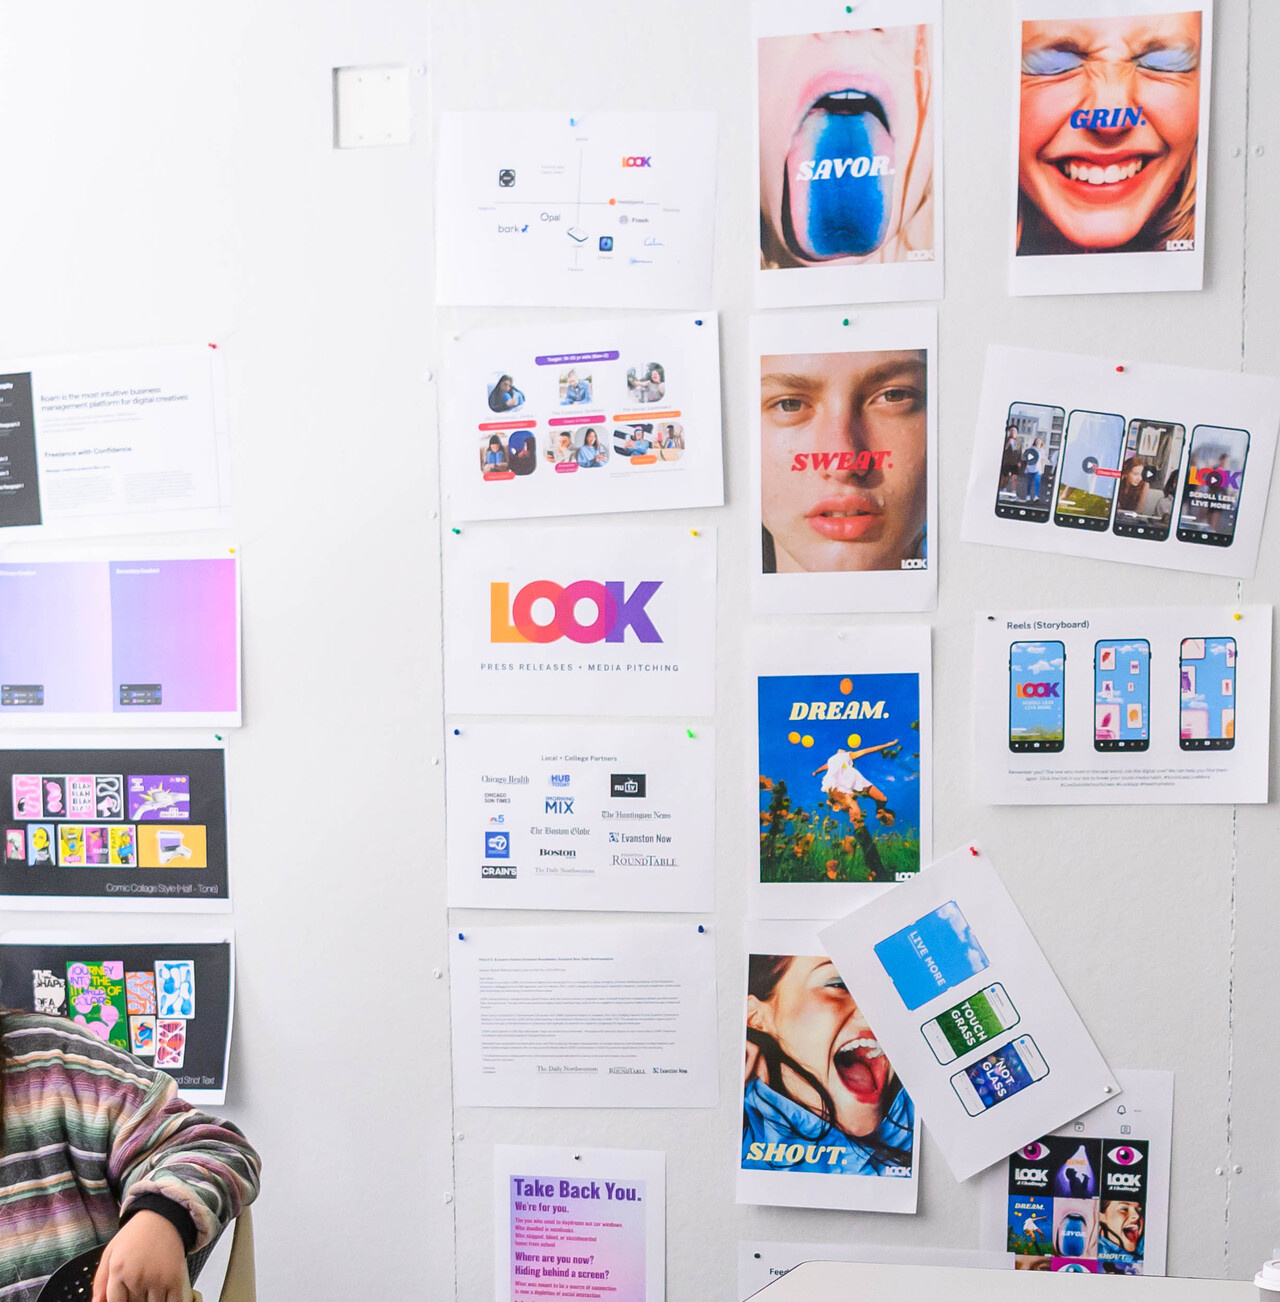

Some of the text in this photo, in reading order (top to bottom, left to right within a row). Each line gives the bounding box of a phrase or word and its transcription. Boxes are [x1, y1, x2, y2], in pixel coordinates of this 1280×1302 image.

[1070, 107, 1147, 130] GRIN.
[622, 157, 652, 168] LOOK
[796, 155, 895, 181] SAVOR.
[540, 212, 560, 223] Opal
[498, 225, 519, 233] bark
[1166, 240, 1194, 251] LOOK
[791, 451, 894, 472] SWEAT.
[1189, 491, 1216, 500] SCROLL
[1191, 500, 1235, 511] LIVE MORE.
[901, 559, 927, 569] LOOK
[491, 580, 664, 644] LOOK
[1034, 620, 1089, 630] (Storyboard)
[1016, 683, 1060, 698] LOOK
[789, 701, 889, 720] DREAM.
[545, 801, 574, 814] MIX
[498, 815, 505, 823] 5
[615, 811, 652, 820] Huntington
[531, 827, 590, 835] The Boston Globe
[621, 833, 671, 843] Evanston Now
[909, 931, 946, 986] LIVE MORE
[71, 966, 114, 976] JOURNEY
[71, 997, 111, 1006] COLORS
[961, 1001, 988, 1041] TOUCH
[951, 1010, 976, 1046] GRASS
[996, 1058, 1015, 1085] NOT
[982, 1061, 1007, 1097] GLASS
[746, 1142, 847, 1165] SHOUT.
[885, 1166, 912, 1176] LOOK
[1015, 1168, 1048, 1182] LOOK
[1107, 1173, 1141, 1186] LOOK
[514, 1179, 642, 1201] Take Back You.
[515, 1201, 569, 1214] We're for you.
[515, 1252, 540, 1262] Where
[557, 1255, 571, 1265] you
[573, 1256, 594, 1264] now?
[515, 1266, 540, 1277] Hiding
[543, 1268, 569, 1277] behind
[578, 1270, 609, 1279] screen?
